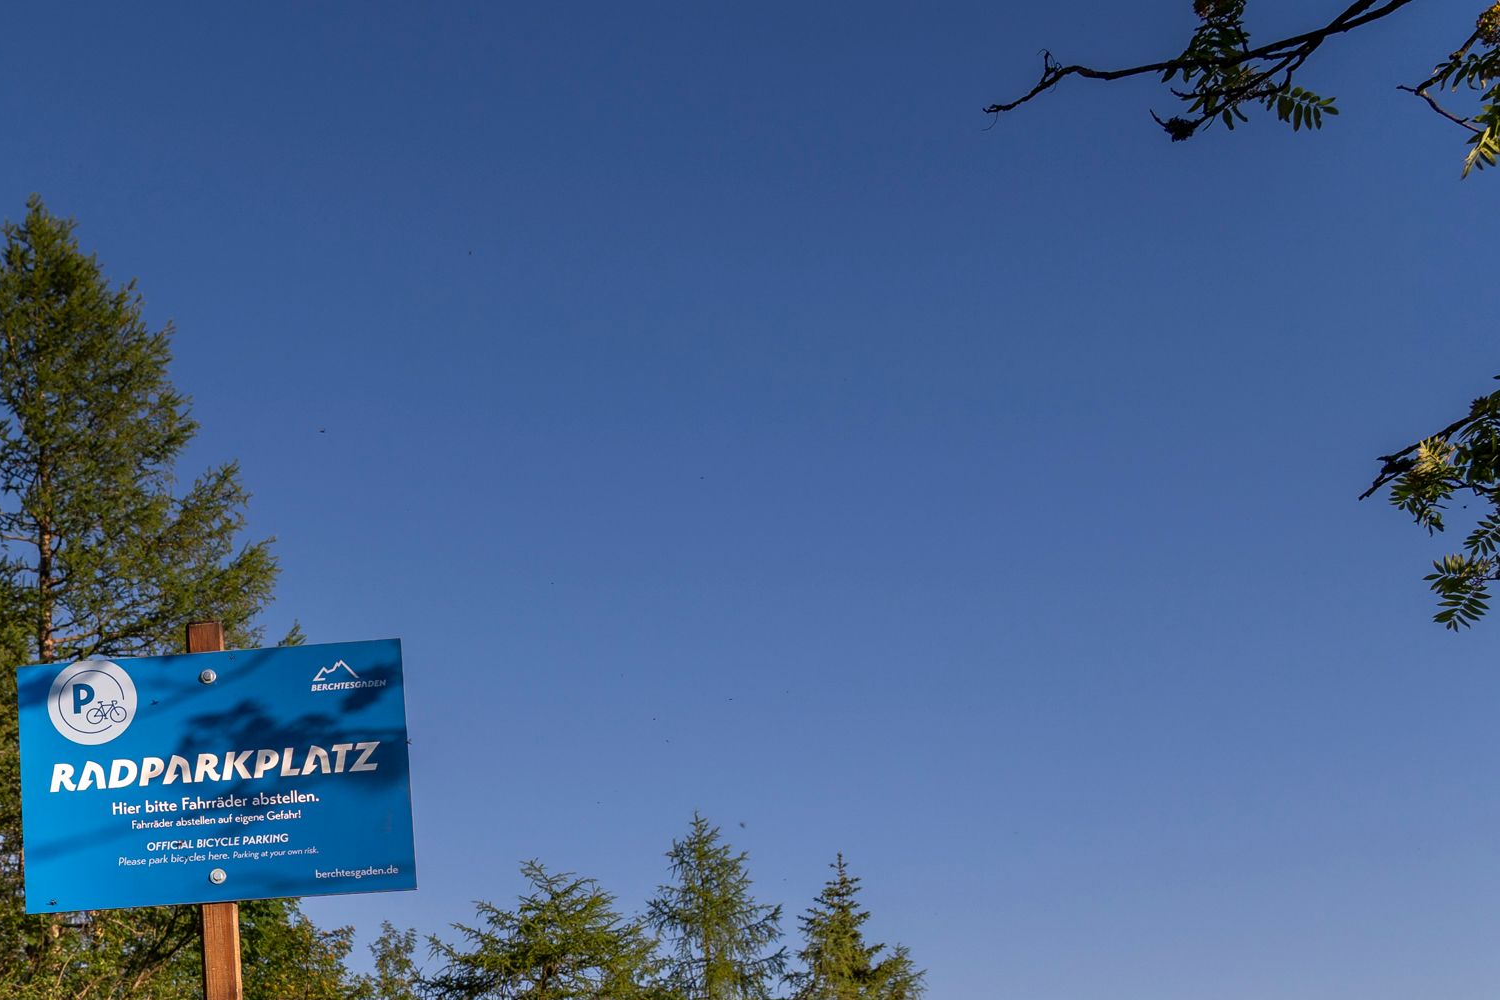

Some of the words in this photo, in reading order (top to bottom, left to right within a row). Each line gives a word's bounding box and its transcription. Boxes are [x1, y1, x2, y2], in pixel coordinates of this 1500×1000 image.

[311, 679, 387, 692] BERCHTESGADEN
[73, 683, 95, 715] P
[50, 741, 381, 793] RADPARKPLATZ
[112, 802, 141, 816] Hier
[146, 800, 177, 814] bitte
[182, 795, 247, 811] Fahrräder
[252, 791, 319, 806] abstellen.
[132, 819, 173, 830] Fahrräder
[176, 816, 216, 827] abstellen
[218, 814, 232, 824] auf
[235, 814, 264, 825] eigene
[267, 810, 301, 821] Gefahr!
[147, 840, 193, 852] OFFICIAL
[197, 837, 240, 849] BICYCLE
[243, 834, 288, 846] PARKING
[119, 857, 146, 867] Please
[149, 854, 168, 867] park
[171, 853, 205, 865] bicycles
[208, 852, 229, 861] here.
[233, 851, 259, 860] Parking
[270, 851, 286, 859] your
[304, 847, 318, 855] risk.
[316, 865, 398, 880] berchtesgaden.de
